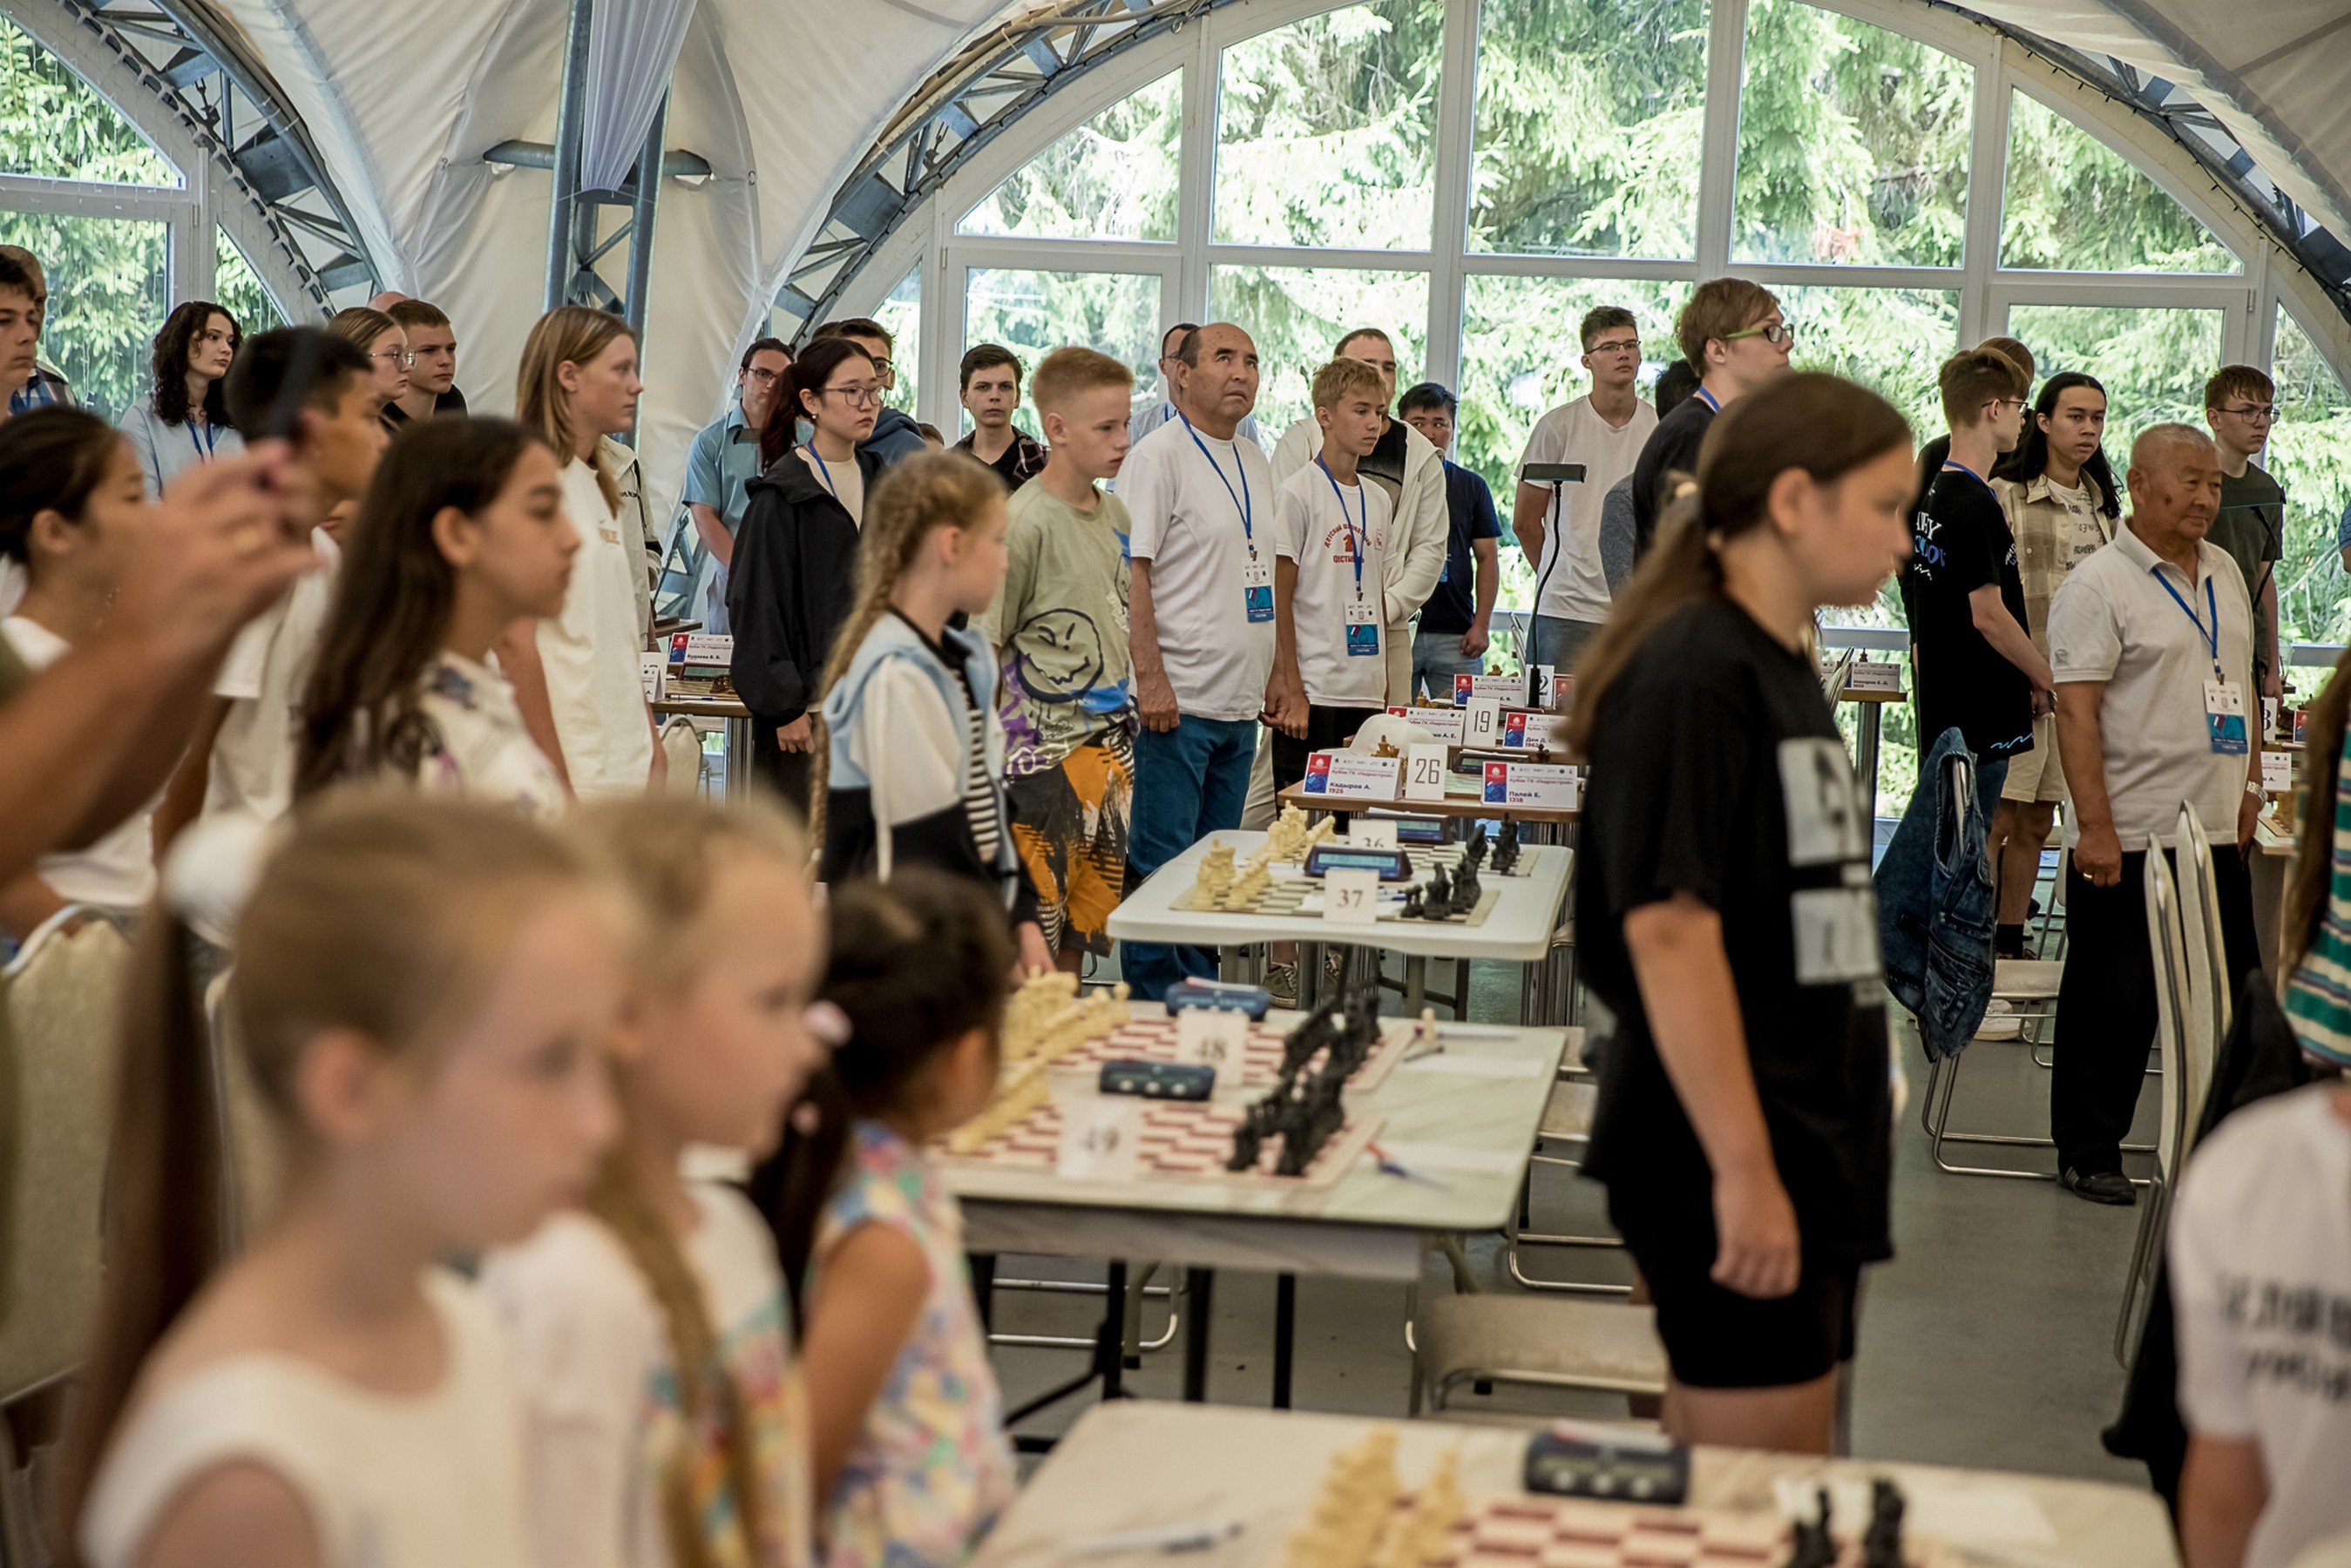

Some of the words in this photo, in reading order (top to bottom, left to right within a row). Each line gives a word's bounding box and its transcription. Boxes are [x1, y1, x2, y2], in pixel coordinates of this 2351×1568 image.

[1474, 711, 1491, 733] 19
[1414, 759, 1440, 784] 26
[1338, 889, 1364, 909] 37
